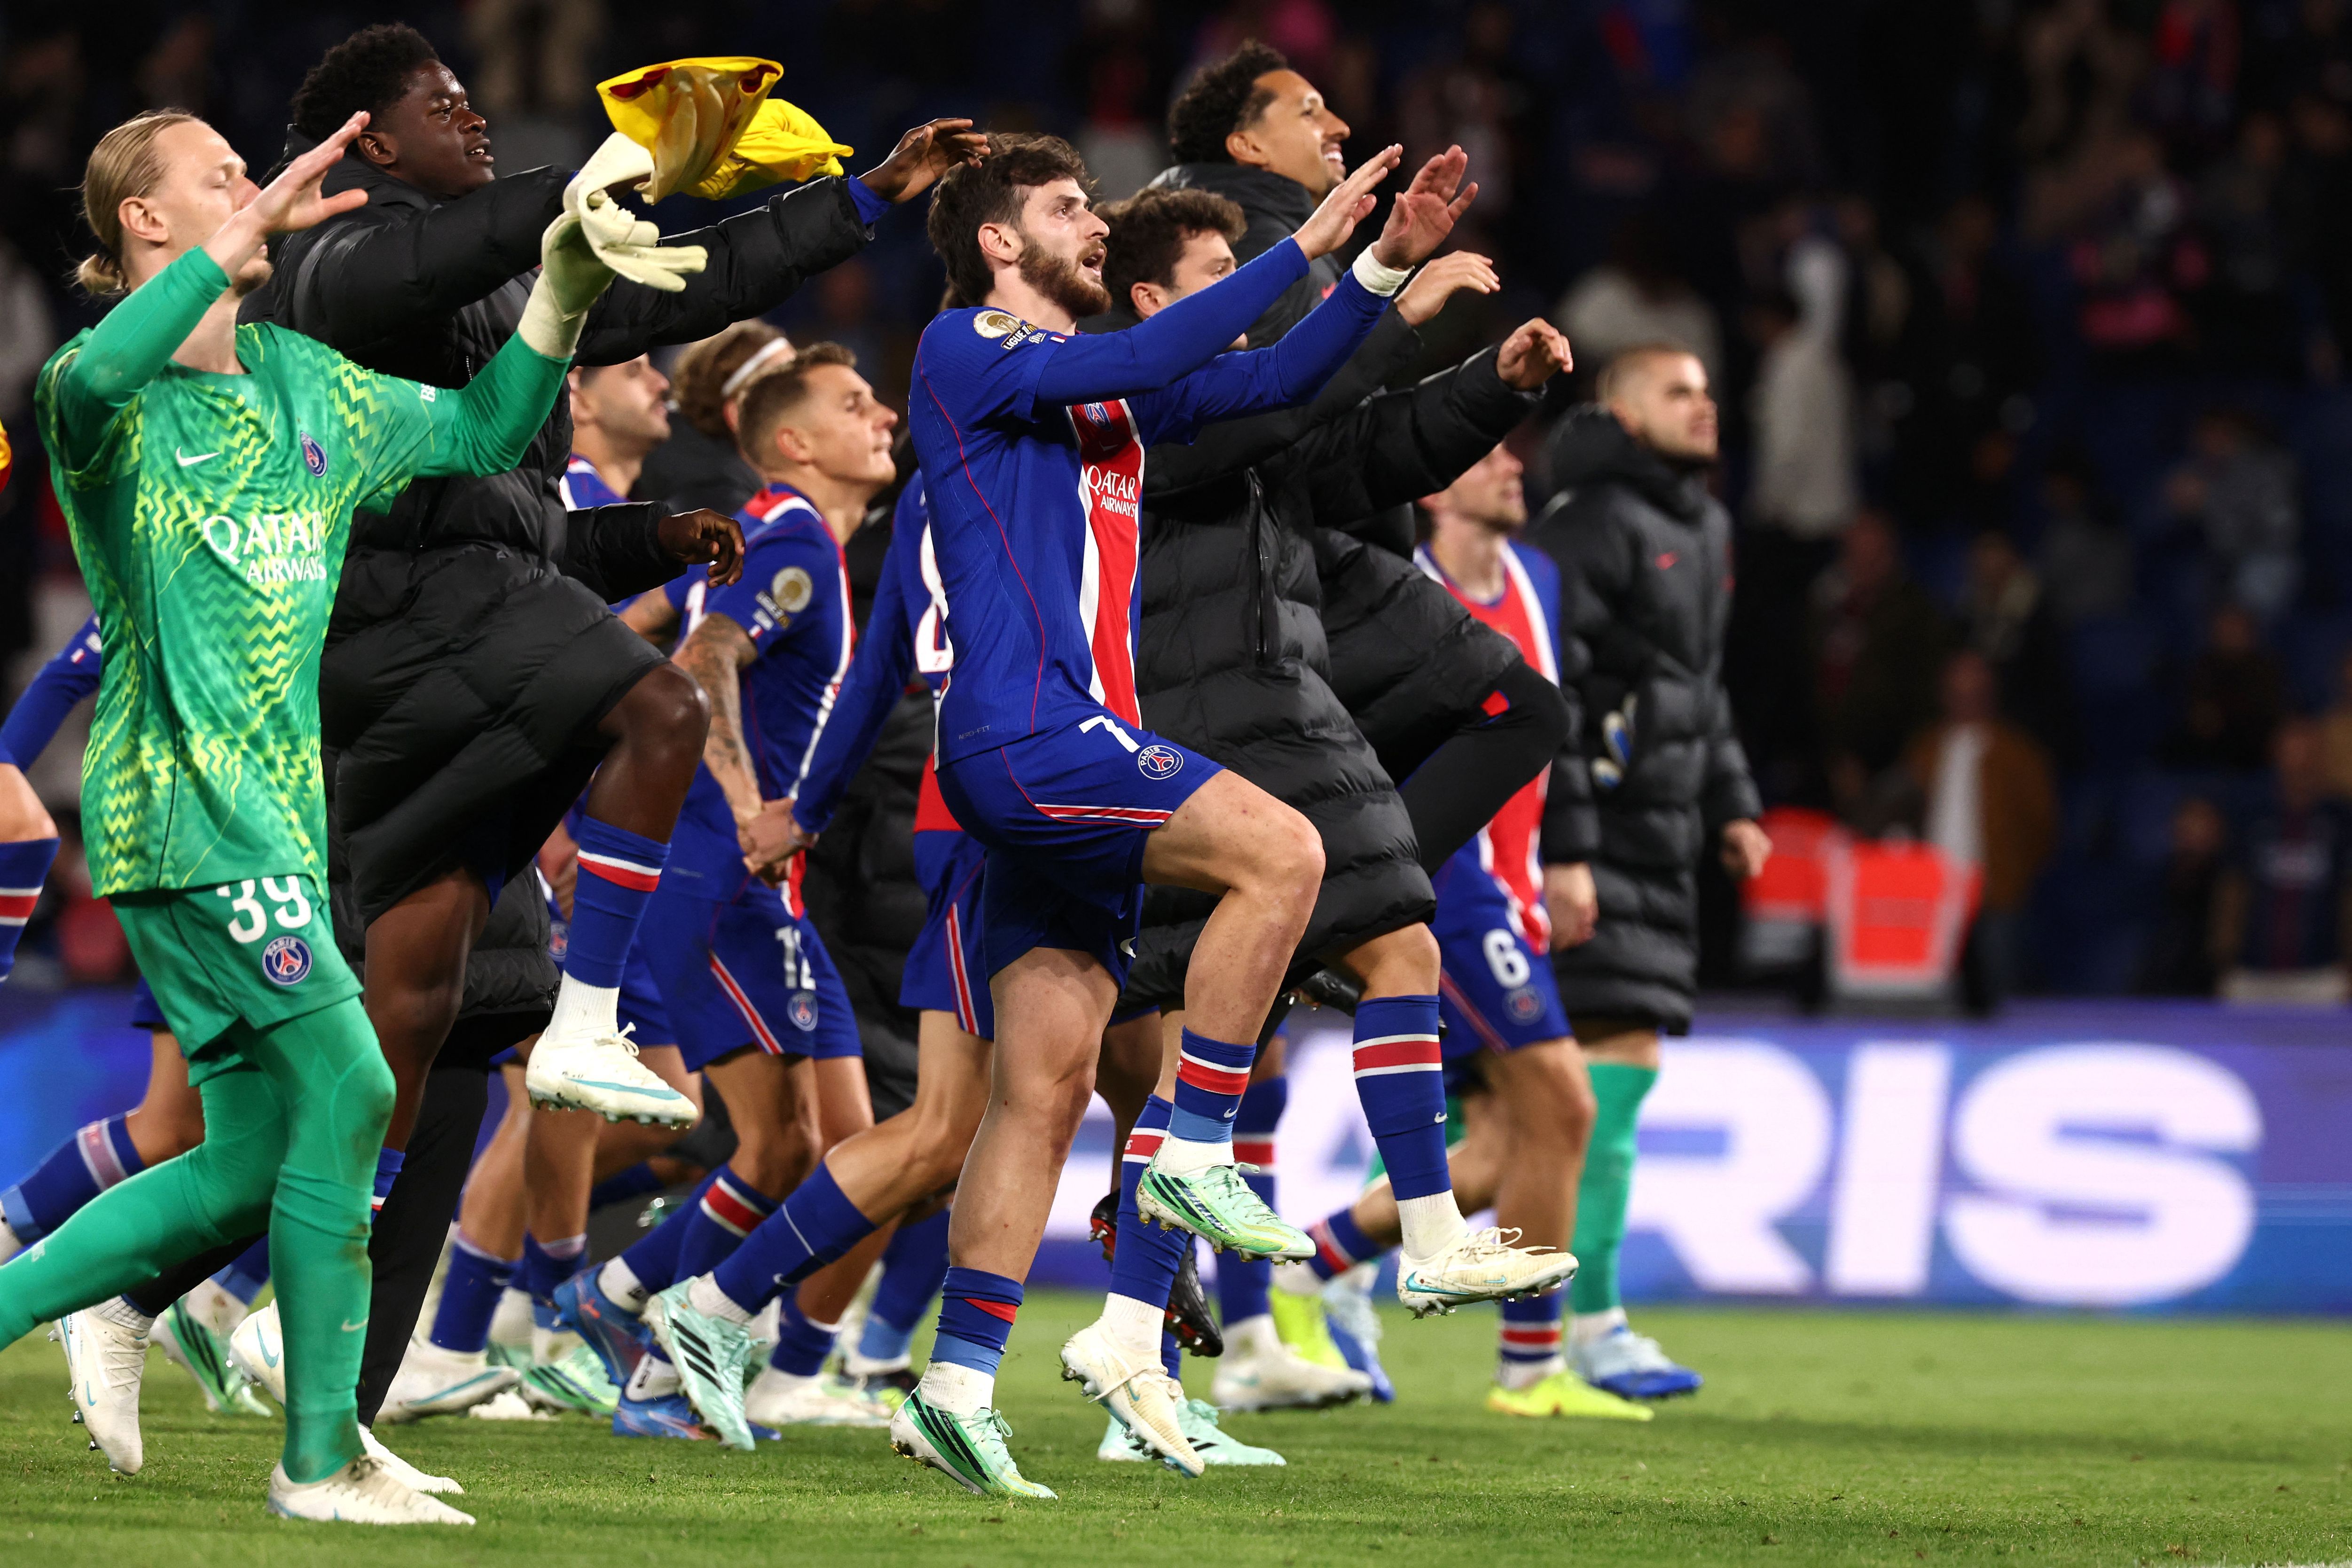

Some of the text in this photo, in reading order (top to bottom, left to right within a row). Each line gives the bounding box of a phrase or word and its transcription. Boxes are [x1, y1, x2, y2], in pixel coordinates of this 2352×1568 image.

[1004, 330, 1027, 350] LIGUE
[1086, 465, 1136, 501] QATAR
[1100, 494, 1136, 517] AIRWAYS
[203, 511, 322, 564] QATAR
[246, 557, 327, 583] AIRWAYS
[1079, 714, 1141, 753] 7
[1140, 746, 1160, 766] PARIS
[216, 875, 312, 944] 39
[1482, 929, 1530, 988] 6
